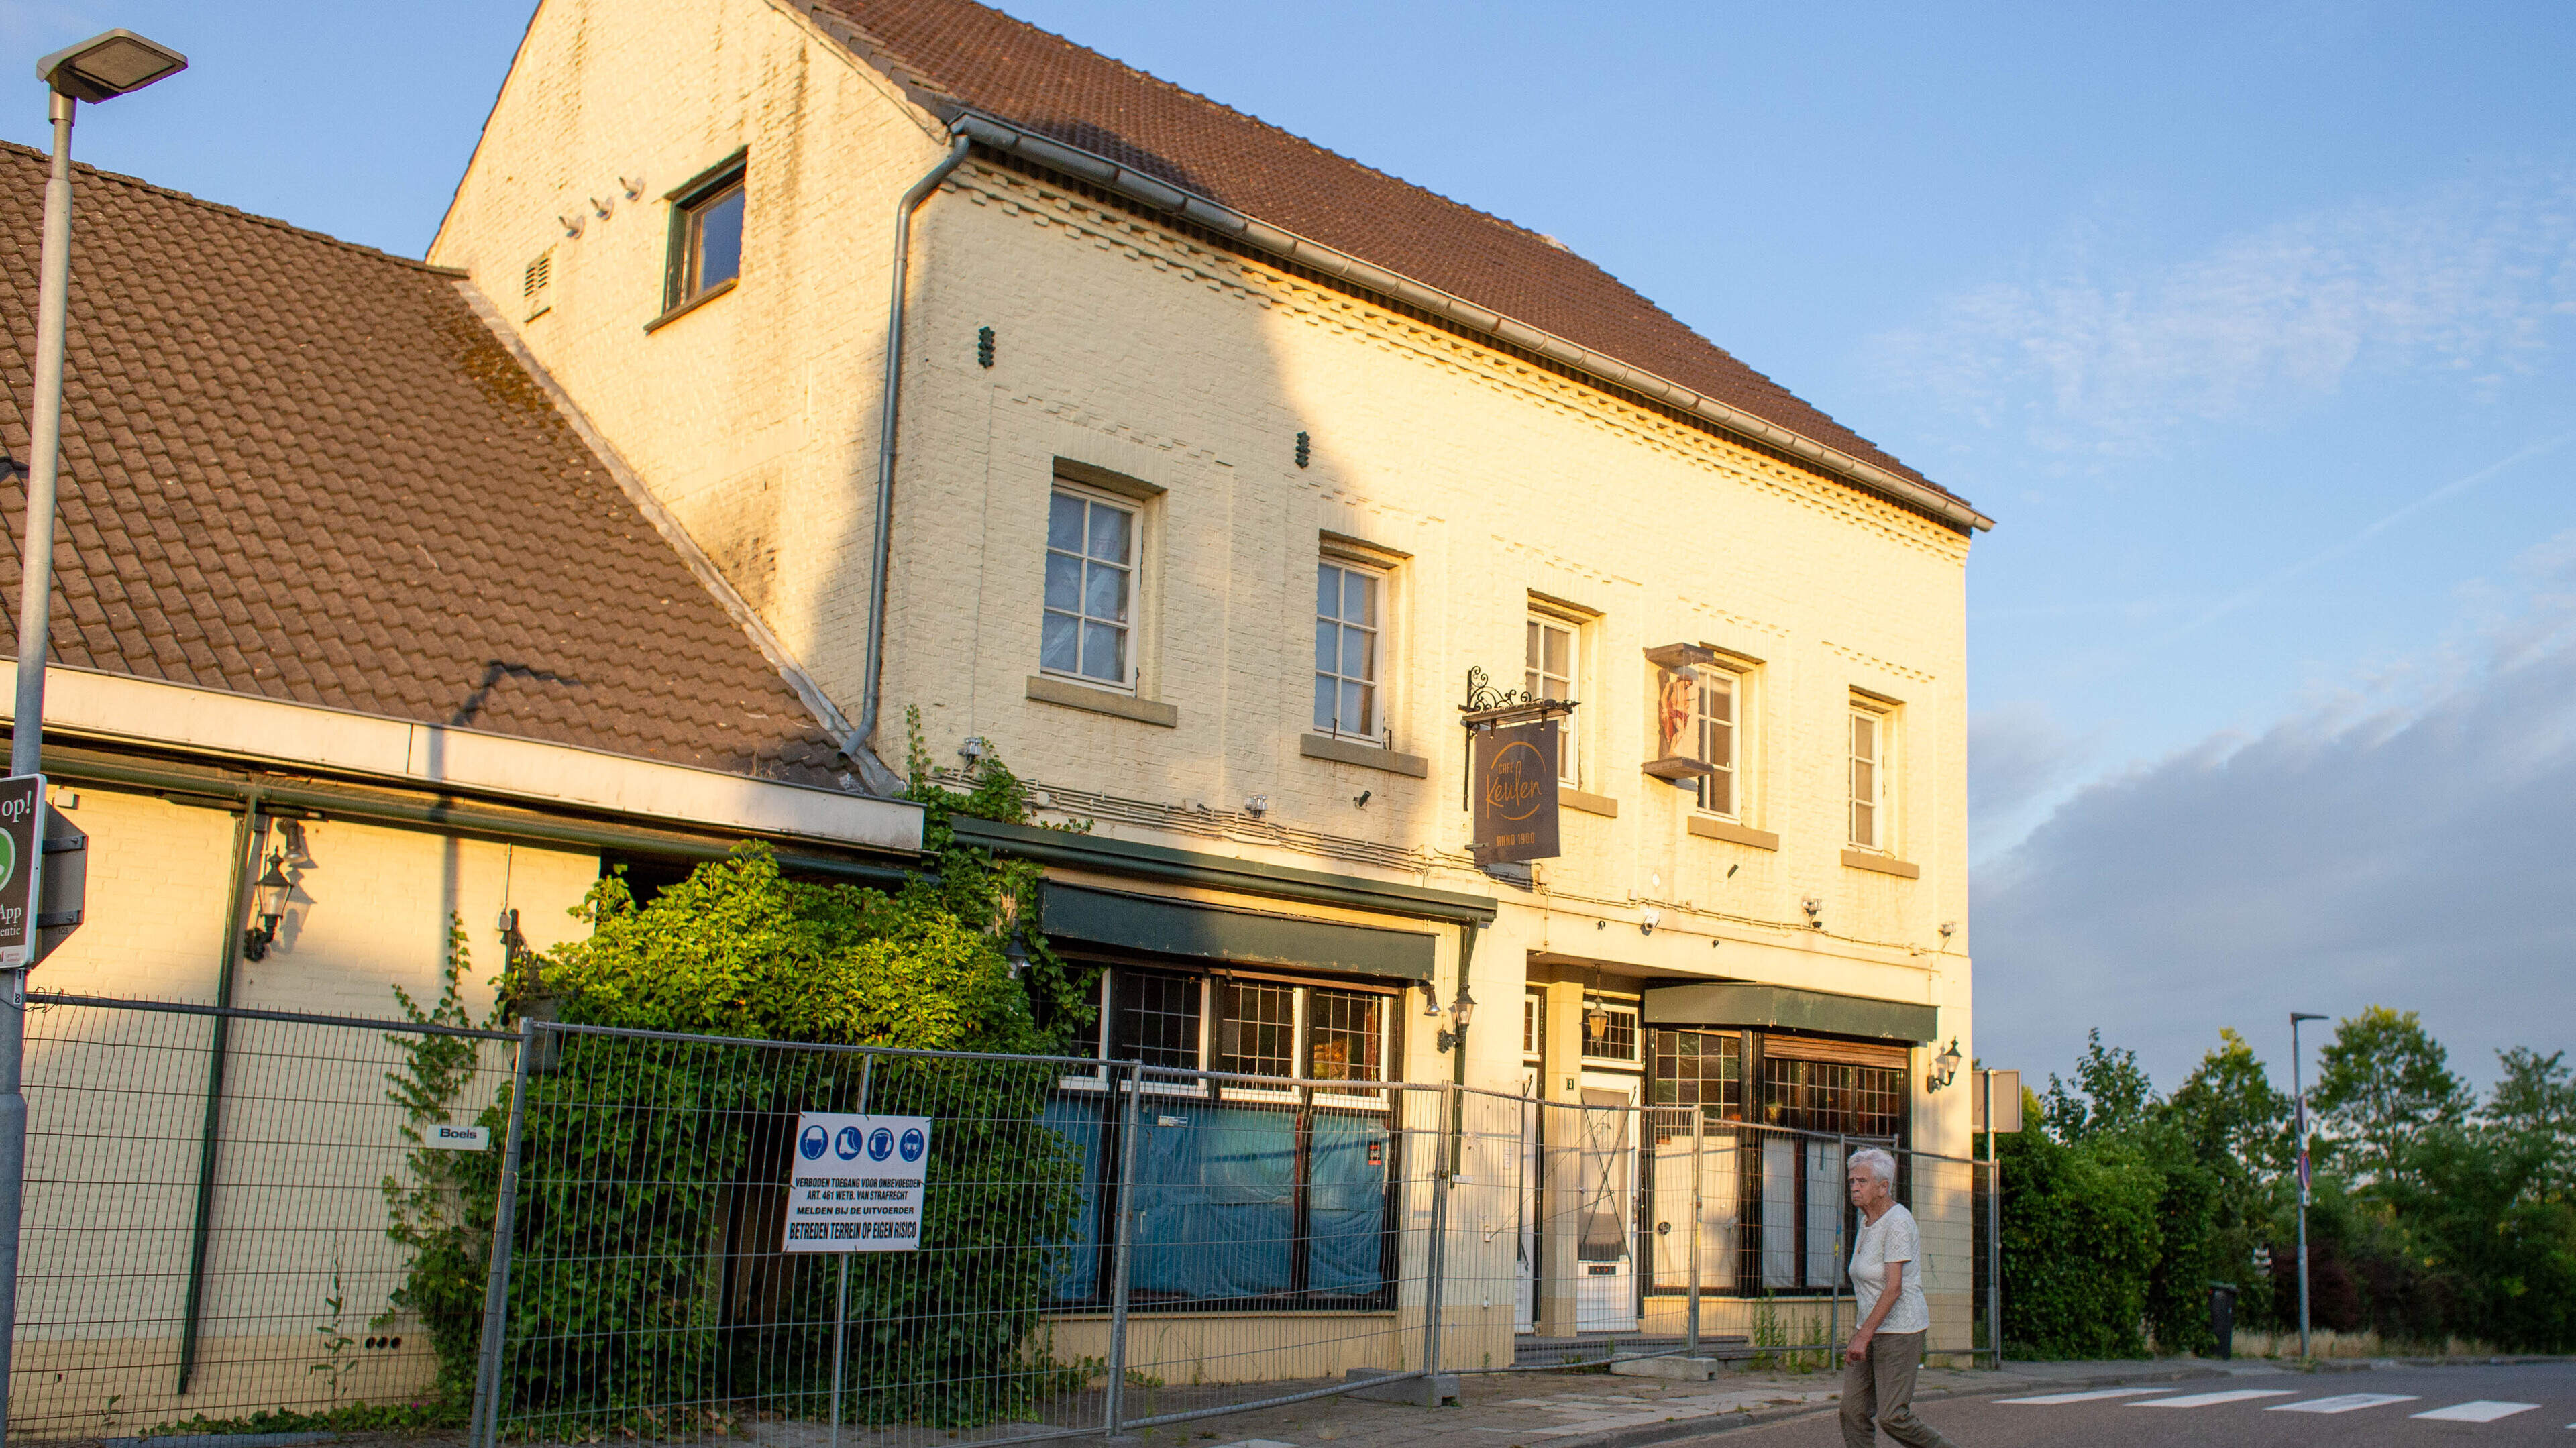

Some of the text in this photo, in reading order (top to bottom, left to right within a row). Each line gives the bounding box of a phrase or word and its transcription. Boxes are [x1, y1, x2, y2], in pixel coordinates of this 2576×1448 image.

[1485, 760, 1542, 819] Keulen
[2, 789, 32, 823] op!
[1497, 832, 1535, 847] ANNO 1900
[440, 1128, 477, 1139] Boels
[796, 1178, 920, 1188] VERBODEN TOEGANG VOOR ONBEVOEGDEN
[807, 1190, 908, 1200] ART. 461 WETB. VAN STRAFRECHT
[789, 1221, 917, 1239] BETREDEN TERREIN OP EIGEN RISICO
